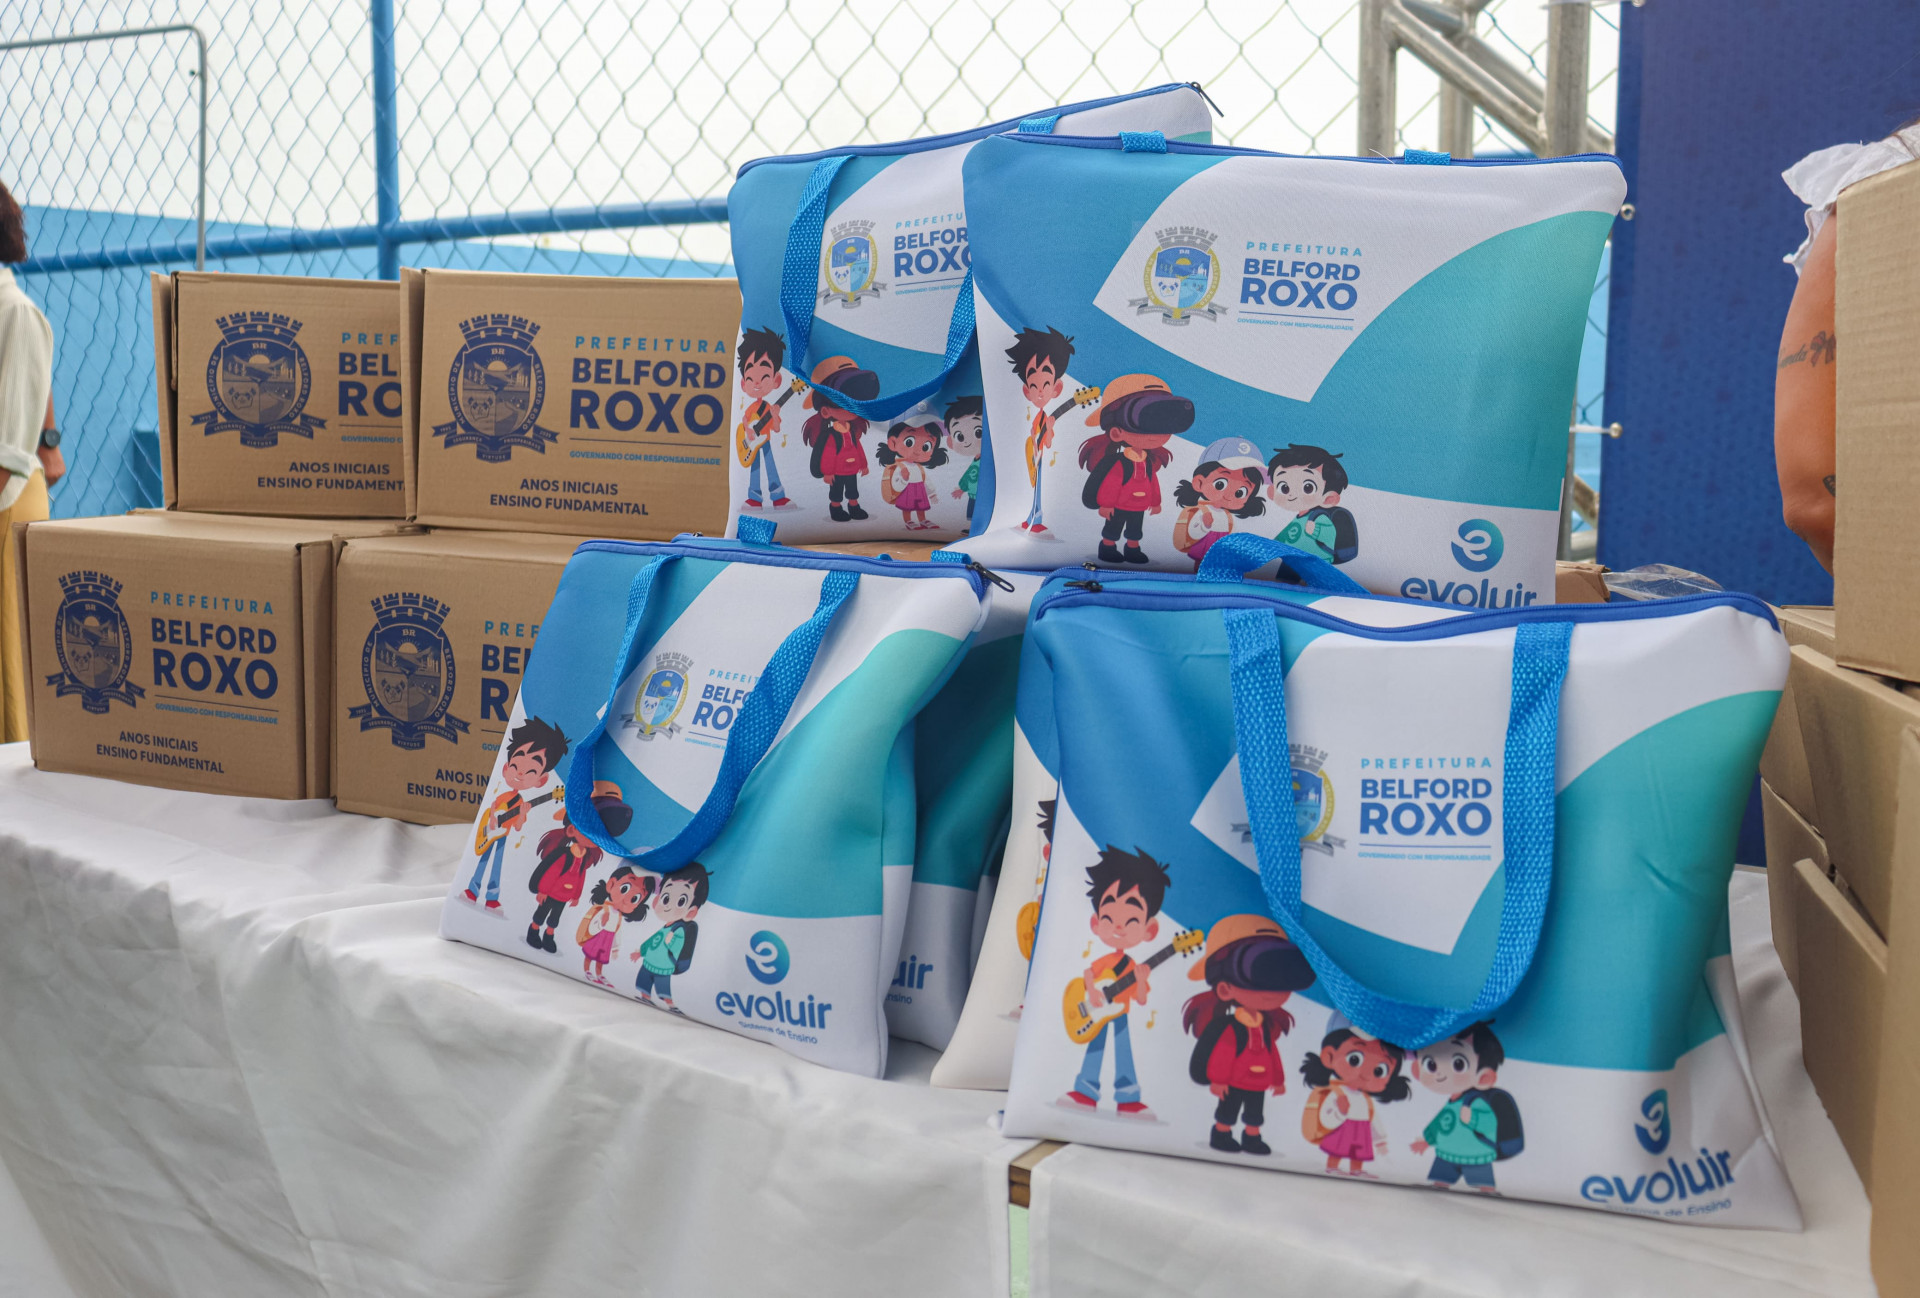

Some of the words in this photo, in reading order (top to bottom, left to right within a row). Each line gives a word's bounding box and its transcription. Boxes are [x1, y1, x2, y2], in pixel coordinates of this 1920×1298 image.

[1246, 241, 1362, 257] PREFEITURA
[1243, 258, 1361, 281] BELFORD
[1240, 277, 1358, 311] ROXO
[575, 336, 726, 354] PREFEITURA
[572, 357, 726, 389] BELFORD
[570, 389, 724, 435] ROXO
[289, 462, 329, 474] ANOS
[333, 463, 390, 475] INICIAIS
[569, 450, 623, 460] GOVERNANDO
[624, 453, 642, 461] COM
[643, 454, 721, 465] RESPONSABILIDADE
[257, 477, 312, 489] ENSINO
[316, 478, 406, 492] FUNDAMENT
[520, 478, 560, 492] ANOS
[562, 480, 618, 495] INICIAIS
[490, 494, 542, 509] ENSINO
[545, 497, 649, 516] FUNDAMENTAL
[150, 591, 274, 615] PREFEITURA
[1400, 577, 1537, 609] evoluir
[151, 618, 277, 655] BELFORD
[152, 648, 279, 700] ROXO
[444, 648, 453, 692] BELFORD
[155, 702, 199, 714] GOVERNANDO
[199, 708, 214, 716] COM
[215, 710, 278, 725] RESPONSABILIDADE
[434, 695, 449, 718] ROXO
[119, 731, 151, 745] ANOS
[152, 735, 199, 753] INICIAIS
[96, 744, 138, 760] ENSINO
[140, 751, 224, 774] FUNDAMENTAL
[1360, 757, 1492, 769] PREFEITURA
[435, 769, 473, 785] ANOS
[1361, 778, 1492, 799] BELFORD
[407, 783, 457, 801] ENSINO
[1360, 802, 1492, 836] ROXO
[715, 991, 832, 1029] evoluir
[787, 1031, 818, 1044] Ensino
[1580, 1148, 1735, 1204] evoluir
[1687, 1198, 1732, 1216] Ensino
